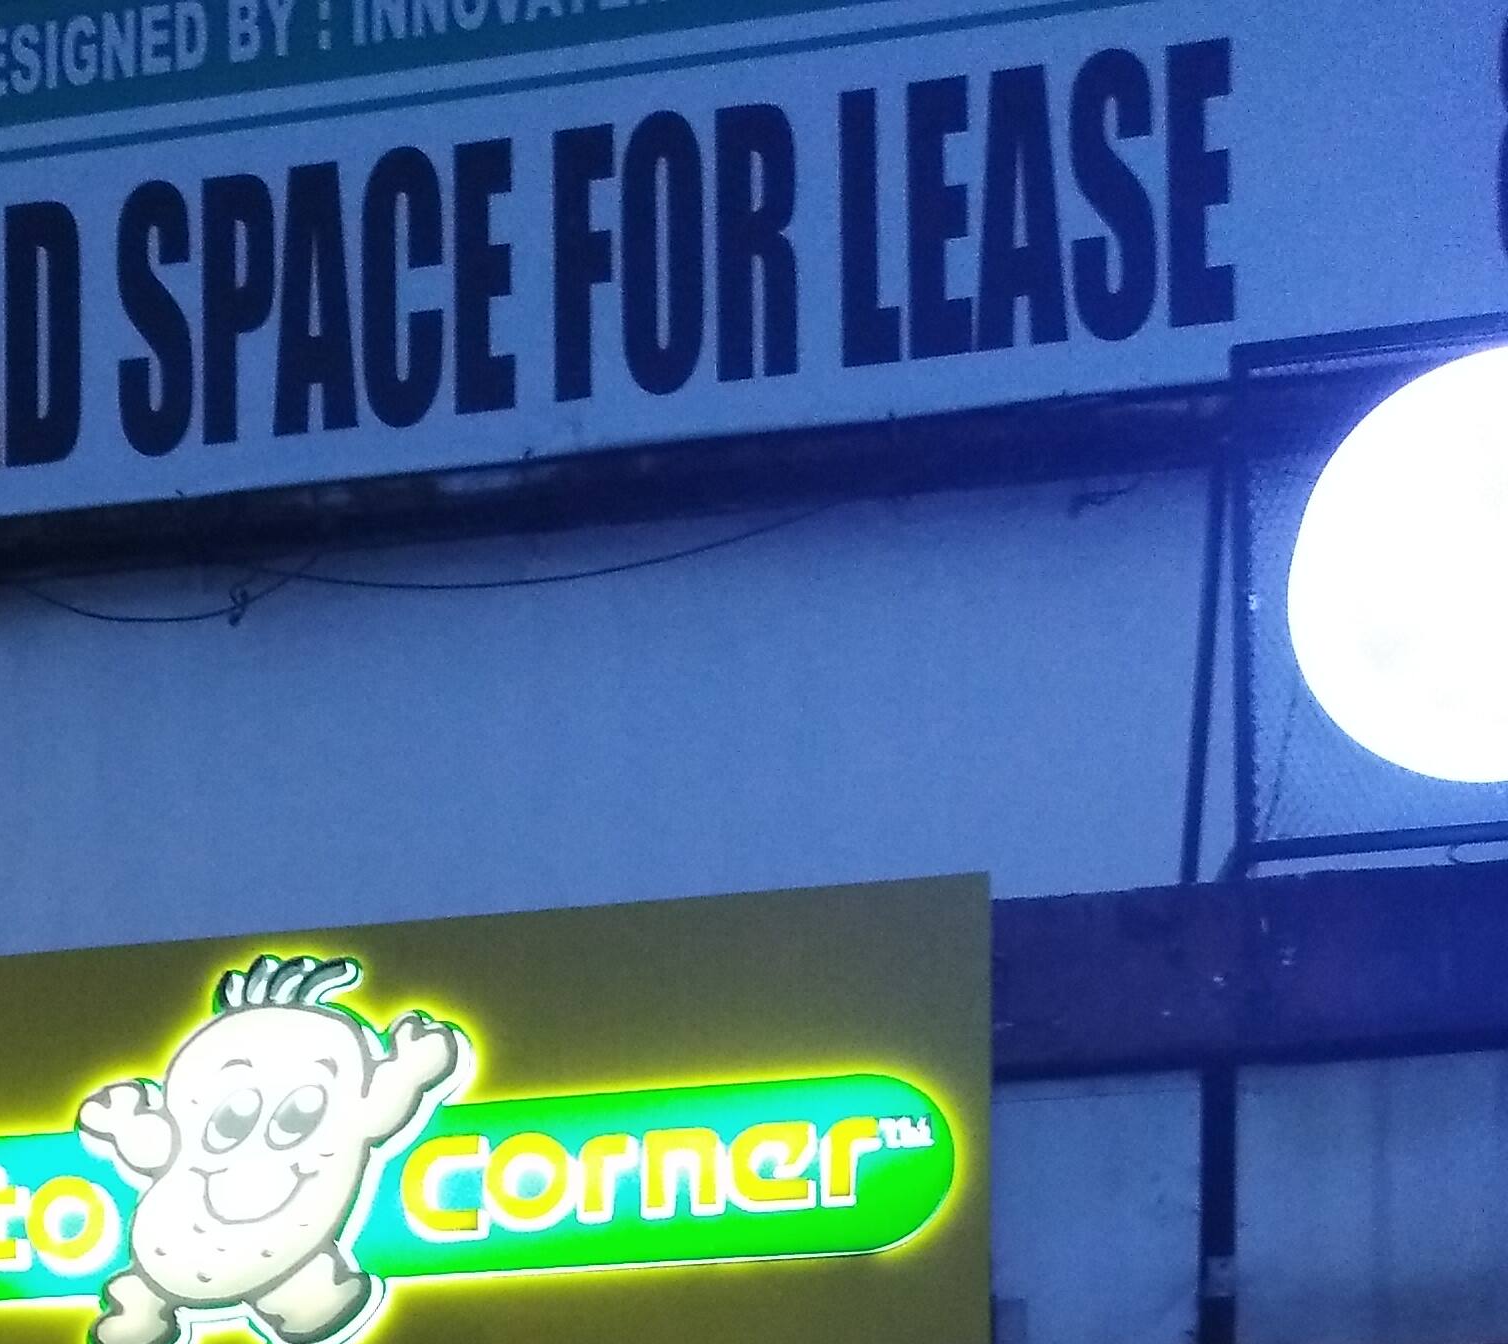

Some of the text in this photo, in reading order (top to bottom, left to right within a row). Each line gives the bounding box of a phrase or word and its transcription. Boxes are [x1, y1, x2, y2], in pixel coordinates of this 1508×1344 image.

[228, 1, 289, 63] BY
[117, 146, 516, 457] SPACE
[552, 103, 798, 402] FOR
[839, 37, 1235, 368] LEASE
